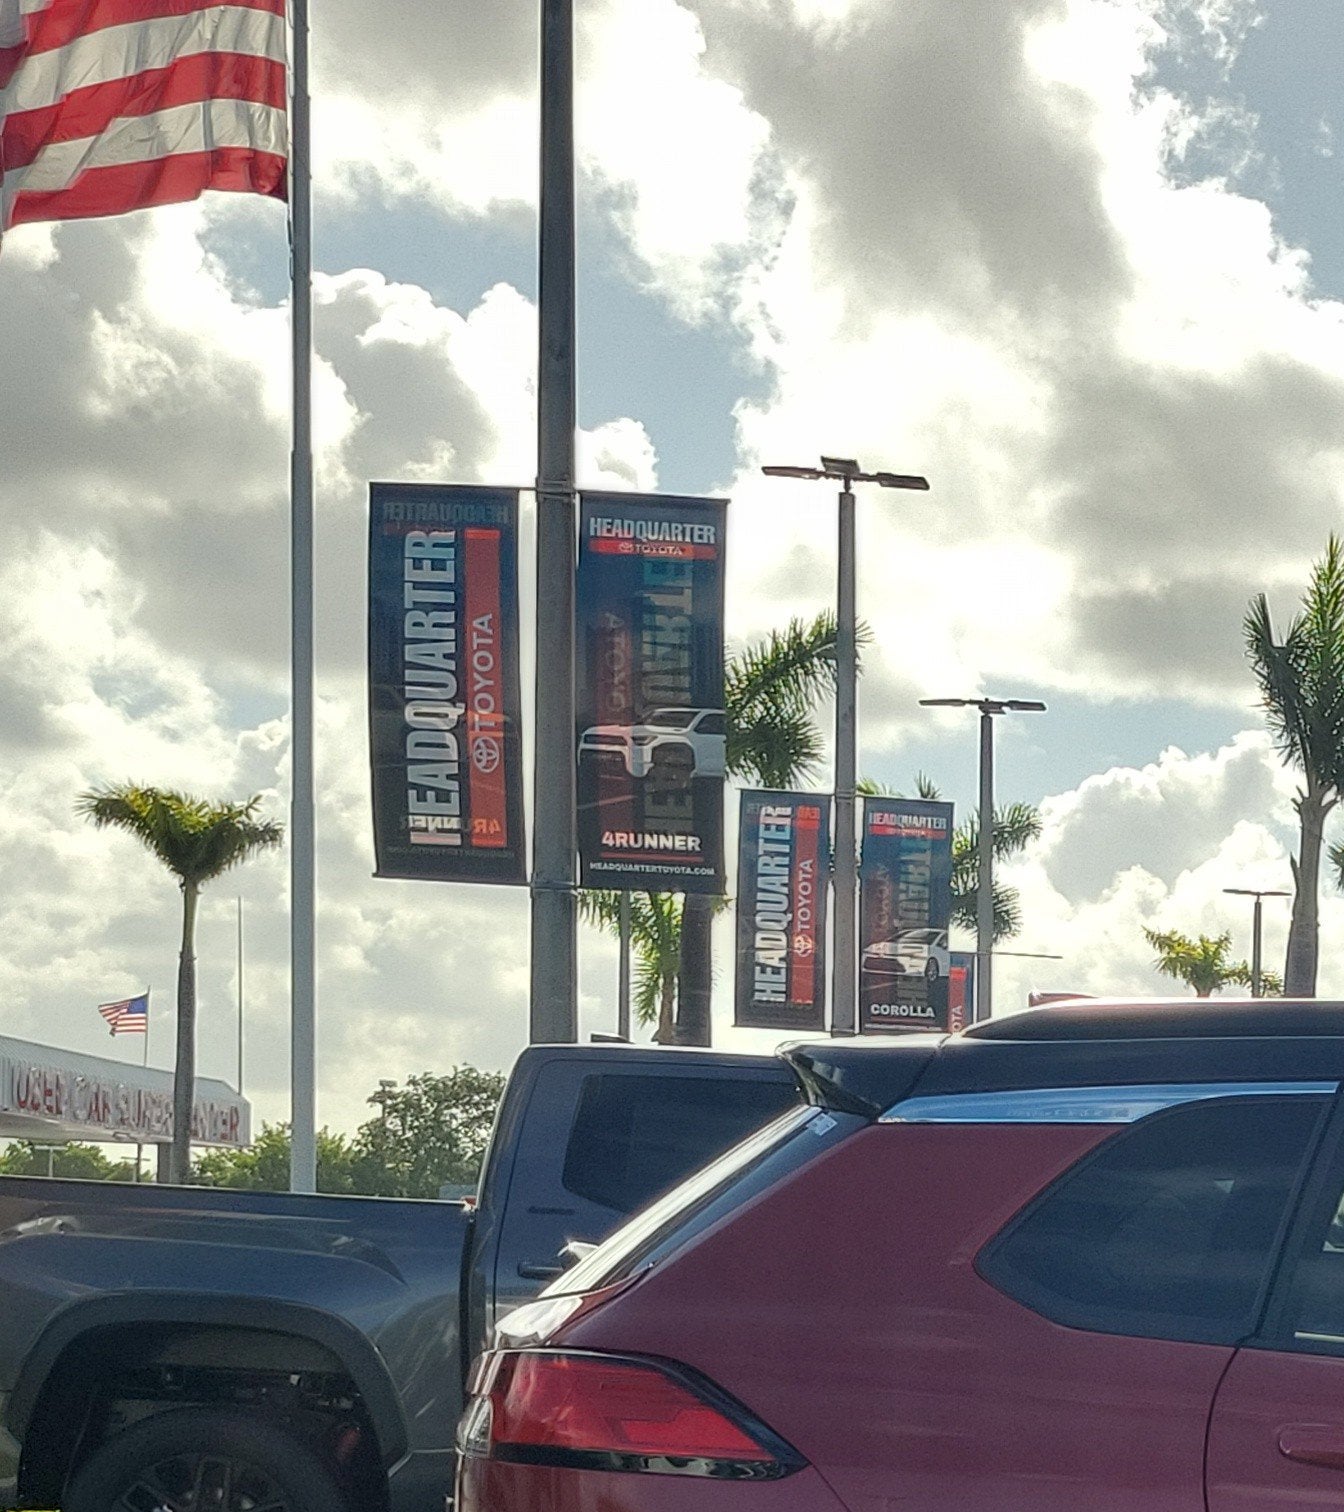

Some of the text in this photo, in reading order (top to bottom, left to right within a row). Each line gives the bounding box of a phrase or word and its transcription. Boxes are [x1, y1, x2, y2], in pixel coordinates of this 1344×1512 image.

[589, 517, 715, 544] HEADQUARTER
[636, 544, 683, 556] TOYOTA
[472, 613, 494, 732] TOYOTA
[405, 530, 466, 846] HEADQUARTER
[601, 831, 702, 851] 4RUNNER
[754, 805, 793, 1003] HEADQUARTER
[797, 859, 815, 932] TOYOTA
[870, 1003, 935, 1018] COROLLA
[952, 1005, 962, 1032] OTA
